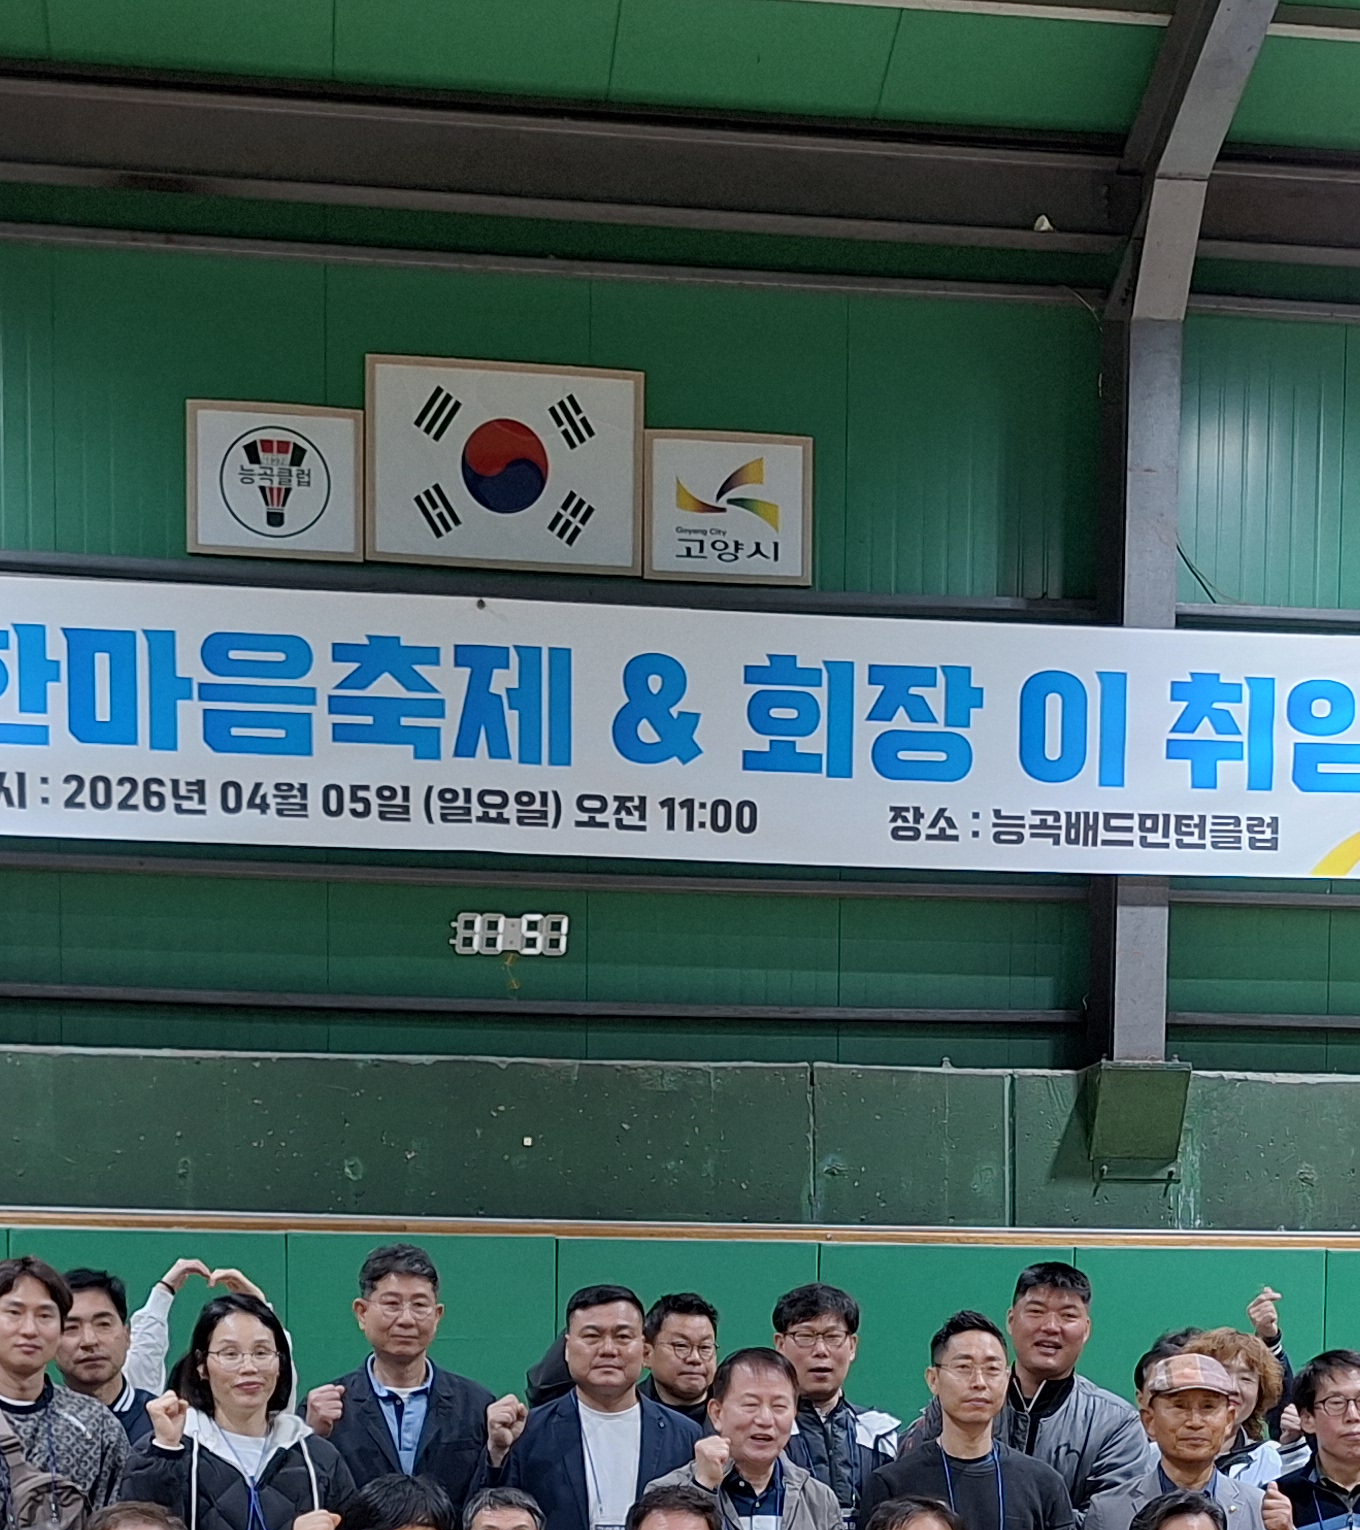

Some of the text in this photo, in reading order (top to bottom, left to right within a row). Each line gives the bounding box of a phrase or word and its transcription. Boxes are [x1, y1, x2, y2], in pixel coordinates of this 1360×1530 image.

[238, 464, 311, 487] 능곡클럽
[675, 538, 779, 562] 고양시
[611, 652, 704, 766] &
[741, 653, 986, 783] 회장
[1018, 669, 1129, 788] 이
[63, 774, 207, 815] 2026년
[220, 780, 310, 818] 04월
[322, 783, 411, 822] 05일
[423, 785, 562, 829] (일요일)
[574, 793, 647, 833] 오전
[658, 797, 758, 834] 11:00
[889, 805, 959, 843] 장소
[991, 808, 1279, 850] 능곡배드민턴클럽
